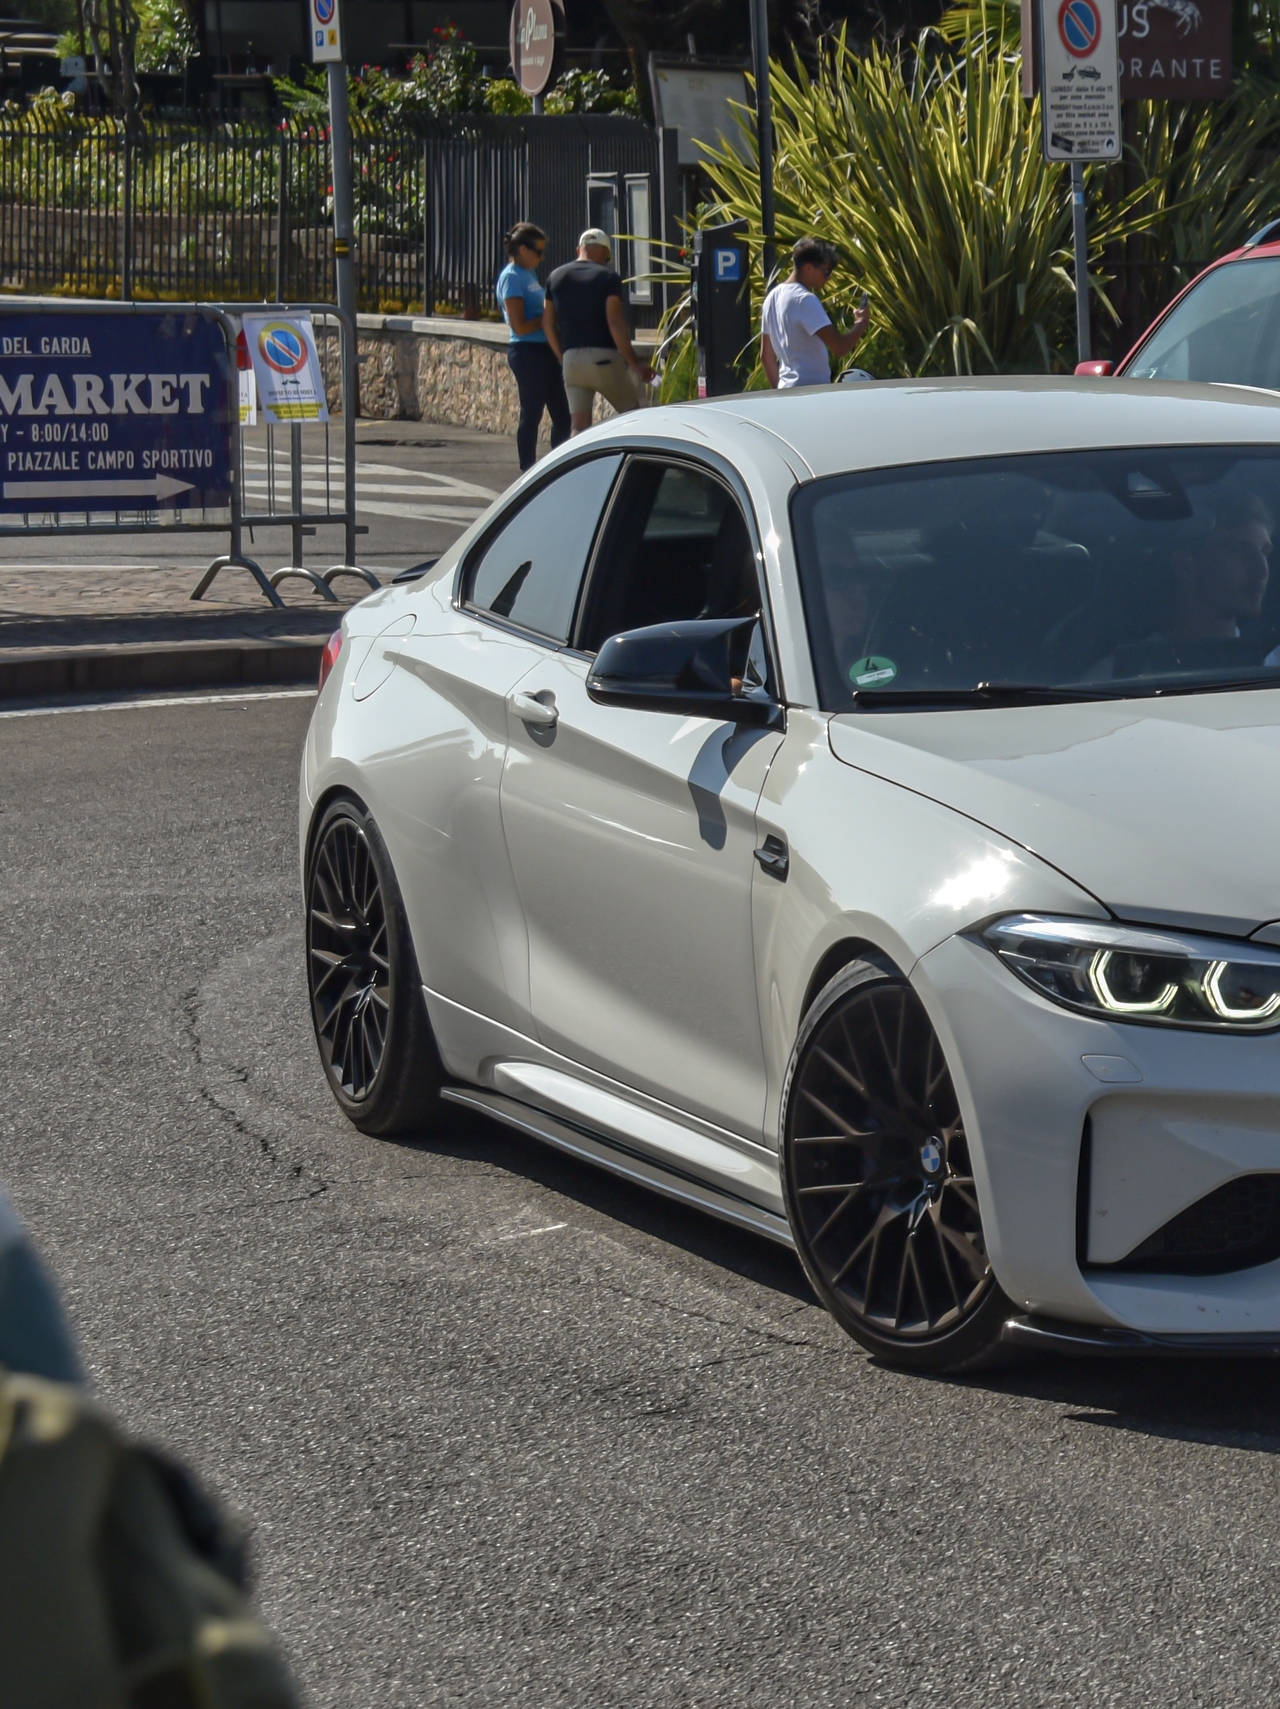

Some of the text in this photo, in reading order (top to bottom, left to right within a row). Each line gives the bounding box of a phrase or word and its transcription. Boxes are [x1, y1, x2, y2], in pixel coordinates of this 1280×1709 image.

[316, 32, 323, 45] P
[718, 251, 736, 276] P
[2, 336, 92, 355] DEL GARDA
[0, 373, 210, 416] MARKET
[31, 422, 109, 442] 8:00/14:00
[8, 449, 213, 471] PIAZZALE CAMPO SPORTIVO
[864, 658, 879, 672] 4
